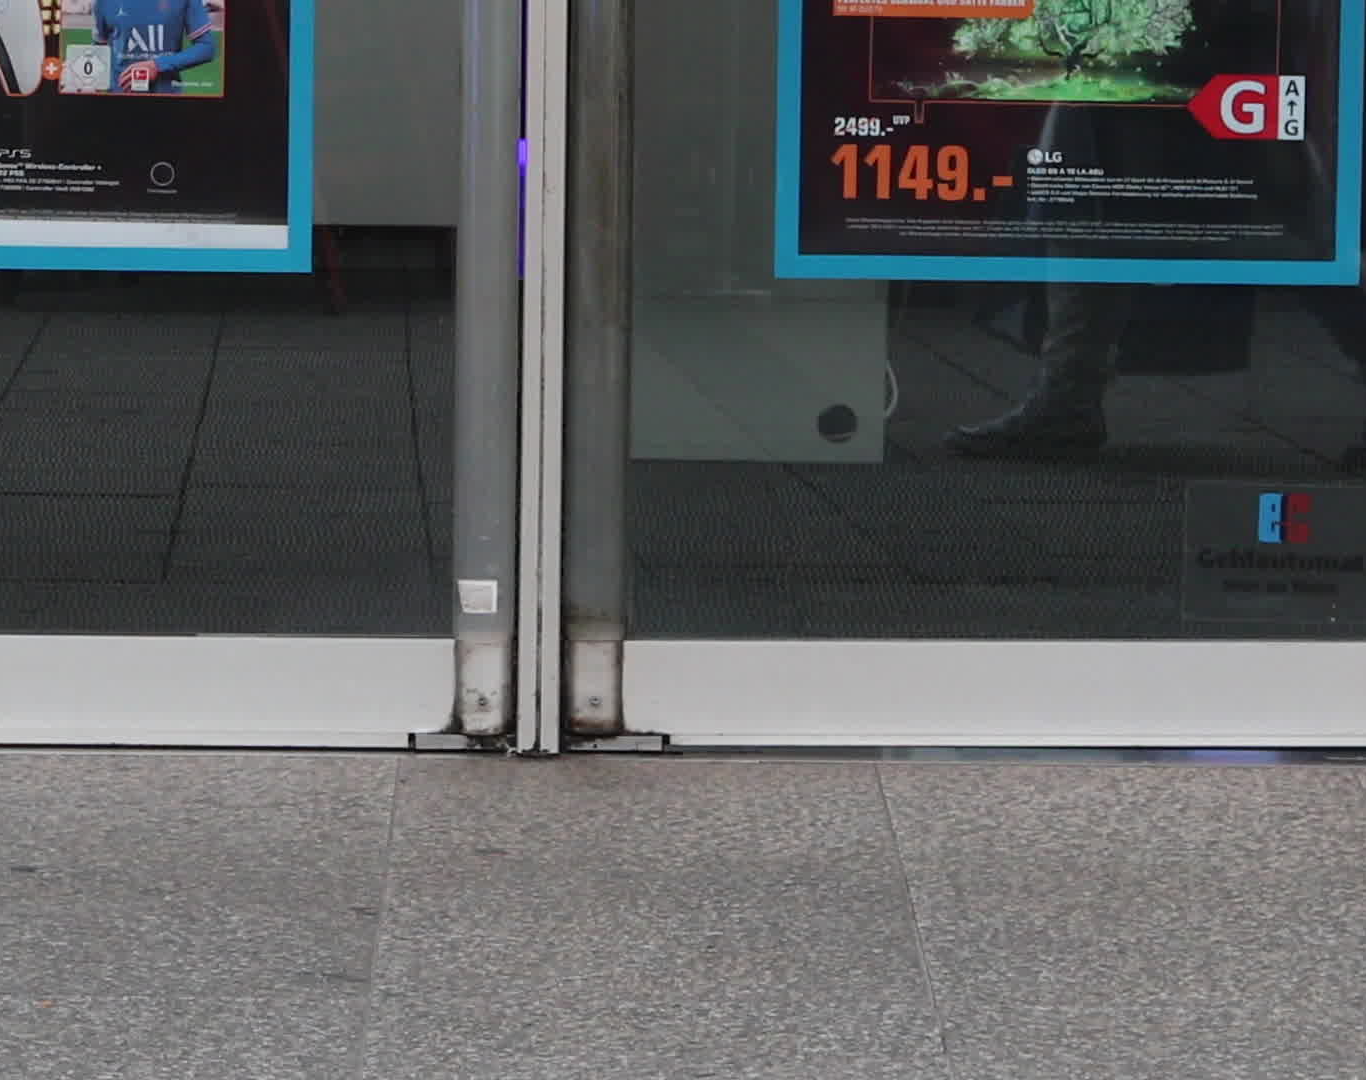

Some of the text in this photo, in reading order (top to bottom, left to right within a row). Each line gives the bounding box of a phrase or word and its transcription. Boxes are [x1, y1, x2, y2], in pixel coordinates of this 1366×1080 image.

[84, 61, 94, 76] 0
[1284, 80, 1301, 98] A
[1220, 81, 1266, 135] G
[893, 115, 911, 125] UVP
[1283, 118, 1300, 137] G
[1045, 151, 1062, 163] LG
[831, 143, 1013, 201] 1149.-
